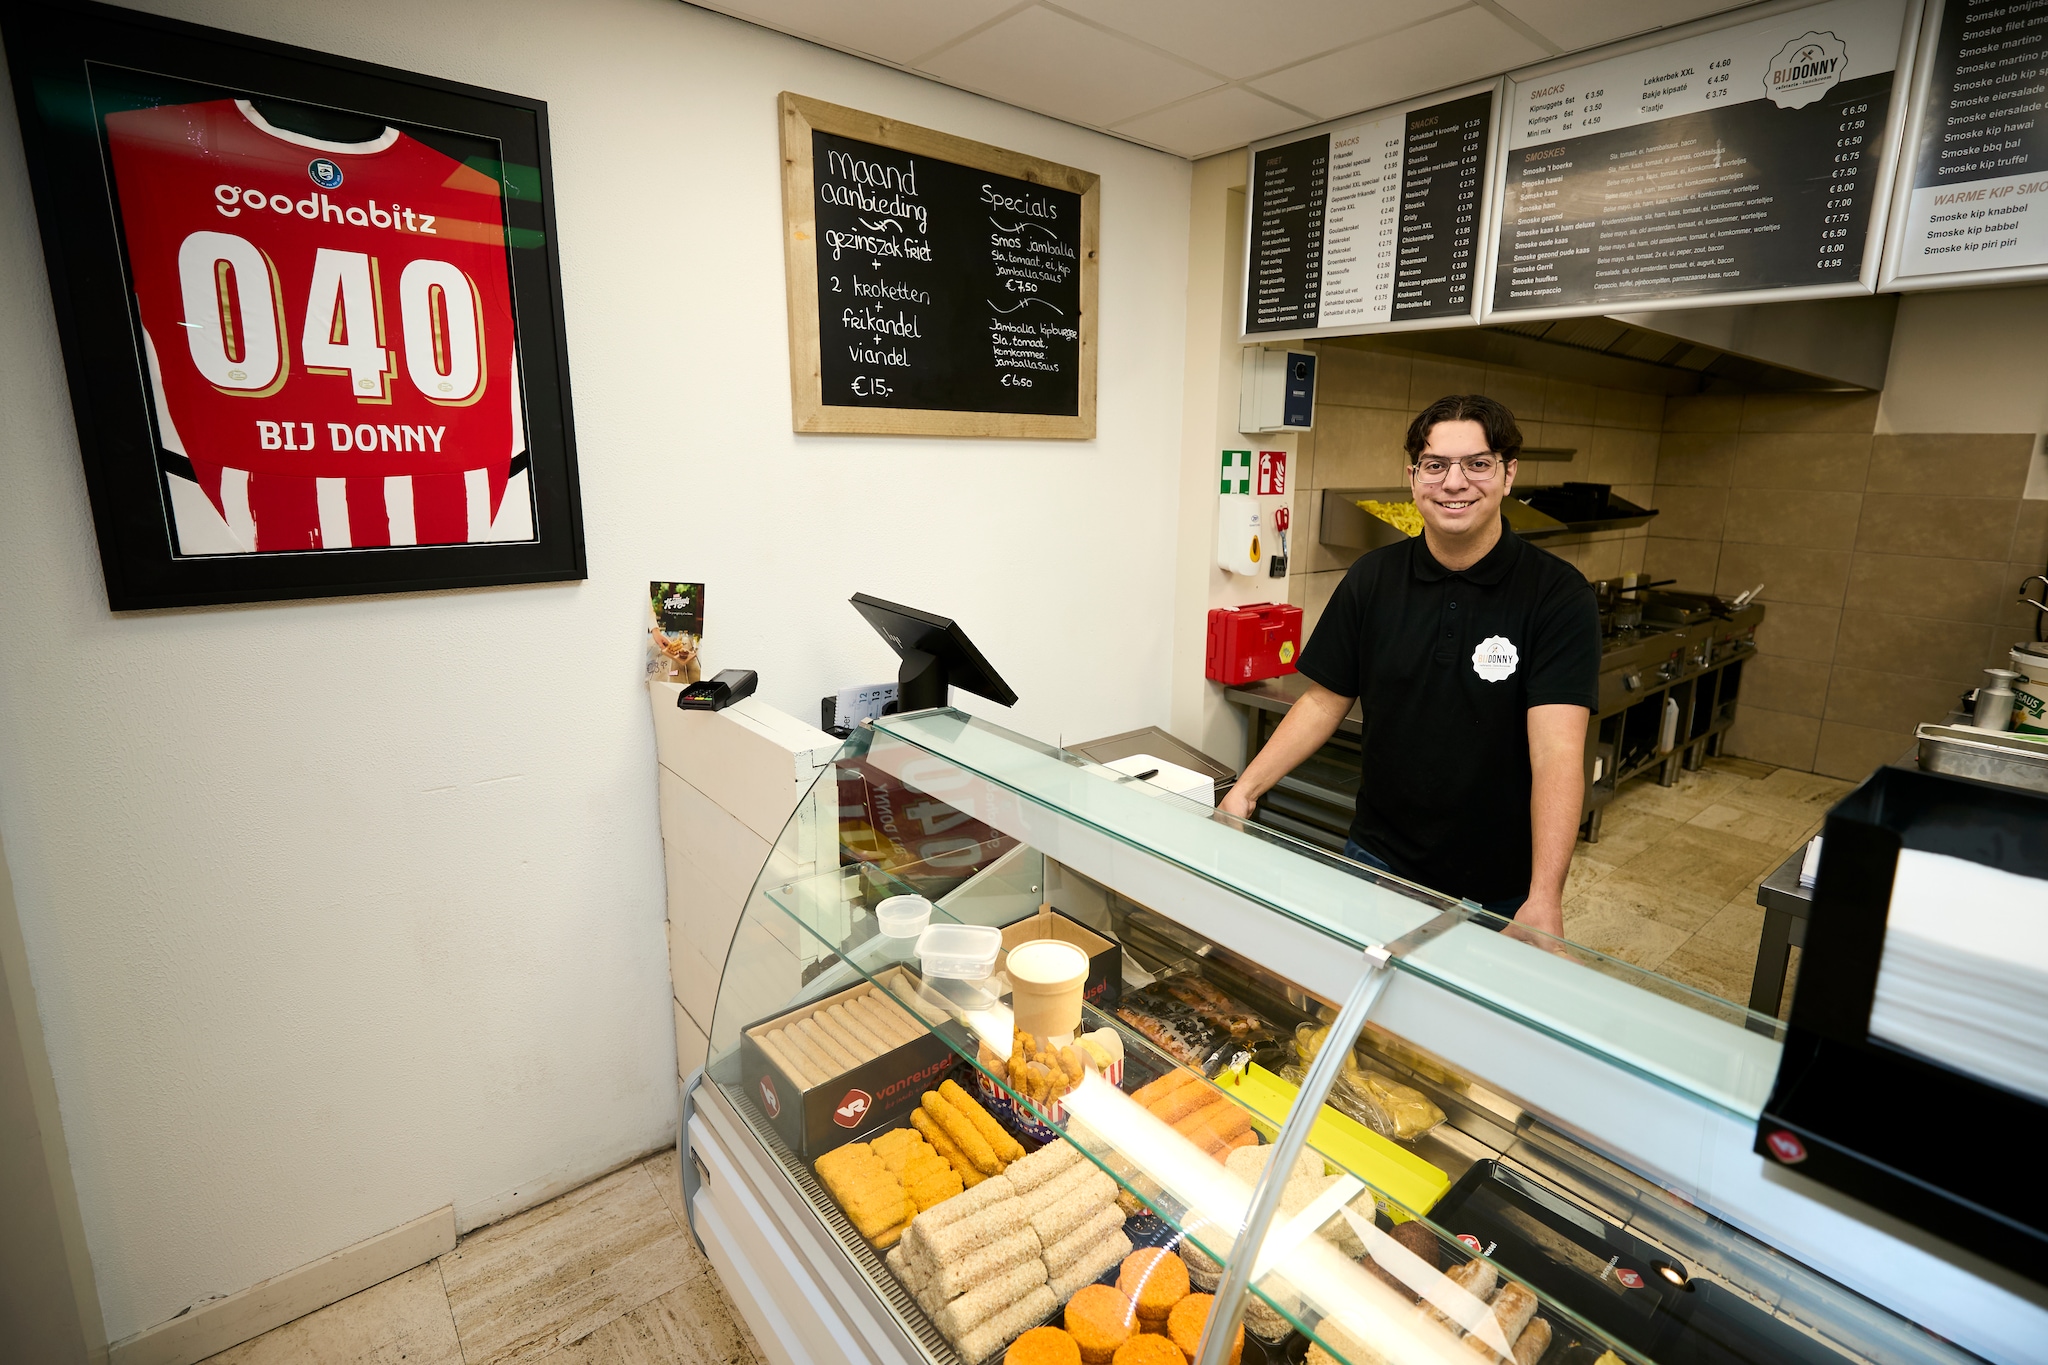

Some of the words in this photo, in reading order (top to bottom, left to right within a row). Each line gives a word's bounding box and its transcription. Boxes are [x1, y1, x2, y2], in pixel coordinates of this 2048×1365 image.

[1965, 8, 2006, 23] Somske
[1962, 26, 2002, 41] Smoske
[2005, 20, 2025, 31] filet
[1959, 44, 1999, 58] Smoske
[2002, 35, 2042, 49] martino
[1716, 58, 1731, 68] 4.60
[1773, 57, 1838, 84] BIJDONNY
[1956, 61, 1996, 75] Smoske
[1999, 53, 2038, 66] martino
[1644, 72, 1678, 86] Lekkerbek
[1680, 68, 1694, 77] XXL
[1714, 73, 1729, 83] 4.50
[1953, 78, 1993, 92] Smoske
[1995, 73, 2017, 84] club
[2020, 69, 2036, 79] kip
[1530, 84, 1565, 100] SNACKS
[1591, 89, 1603, 98] 3.50
[1642, 90, 1661, 100] Bakje
[1662, 83, 1688, 95] kipsaté
[1712, 88, 1727, 98] 3.75
[1950, 96, 1989, 109] Smoske
[1992, 85, 2045, 101] eiersalade
[1530, 100, 1563, 112] Kipnuggets
[1589, 103, 1602, 112] 3.50
[1641, 103, 1664, 113] Slaatje
[1947, 113, 1986, 126] Smoske
[1989, 102, 2041, 118] eiersalade
[1528, 114, 1558, 125] Kipfingers
[1588, 116, 1600, 124] 4.50
[1944, 130, 1983, 142] Smoske
[1986, 126, 2001, 136] kip
[2004, 120, 2034, 132] hawai
[1334, 136, 1360, 149] SNACKS
[1941, 146, 1980, 159] Smoske
[1983, 143, 2002, 152] bbq
[2005, 138, 2021, 149] bal
[1333, 150, 1353, 160] Frikandel
[1525, 147, 1566, 162] SMOSKES
[1842, 151, 1860, 161] 6.75
[1333, 161, 1352, 170] Frikandel
[1353, 157, 1371, 167] speciaal
[1938, 163, 1977, 175] Smoske
[1979, 160, 1995, 170] kip
[1998, 154, 2028, 166] truffel
[1332, 173, 1352, 182] Frikandel
[980, 184, 1057, 219] Specials
[1934, 189, 1987, 206] WARME
[1989, 186, 2014, 199] KIP
[214, 184, 437, 234] goodhabitz
[821, 183, 927, 234] aanbieding
[1930, 212, 1968, 223] Smoske
[1970, 210, 1985, 219] kip
[1988, 204, 2028, 216] knabbel
[1517, 216, 1540, 225] Smoske
[1541, 212, 1563, 223] gezond
[1832, 213, 1849, 223] 7.75
[1516, 229, 1539, 237] Smoske
[1927, 228, 1965, 239] Smoske
[1967, 226, 1982, 236] kip
[1985, 221, 2019, 232] babbel
[826, 227, 903, 260] gezinszak
[904, 238, 932, 261] friet
[991, 234, 1021, 248] Smos
[1027, 236, 1076, 259] jamballa
[1924, 244, 1962, 255] Smoske
[1964, 242, 1979, 251] kip
[1981, 240, 1998, 250] piri
[2000, 238, 2017, 248] piri
[1513, 265, 1535, 273] Smoske
[1824, 259, 1842, 268] 8.95
[830, 276, 842, 292] 2
[854, 274, 930, 305] kroketten
[1510, 289, 1532, 297] Smoske
[1533, 286, 1561, 296] carpaccio
[178, 231, 487, 406] 040
[842, 307, 921, 338] frikandel
[849, 342, 911, 367] viandel
[256, 421, 315, 450] BIJ
[328, 423, 446, 452] DONNY
[872, 691, 880, 702] 13
[884, 689, 893, 699] 14
[876, 1053, 953, 1100] vanreusel
